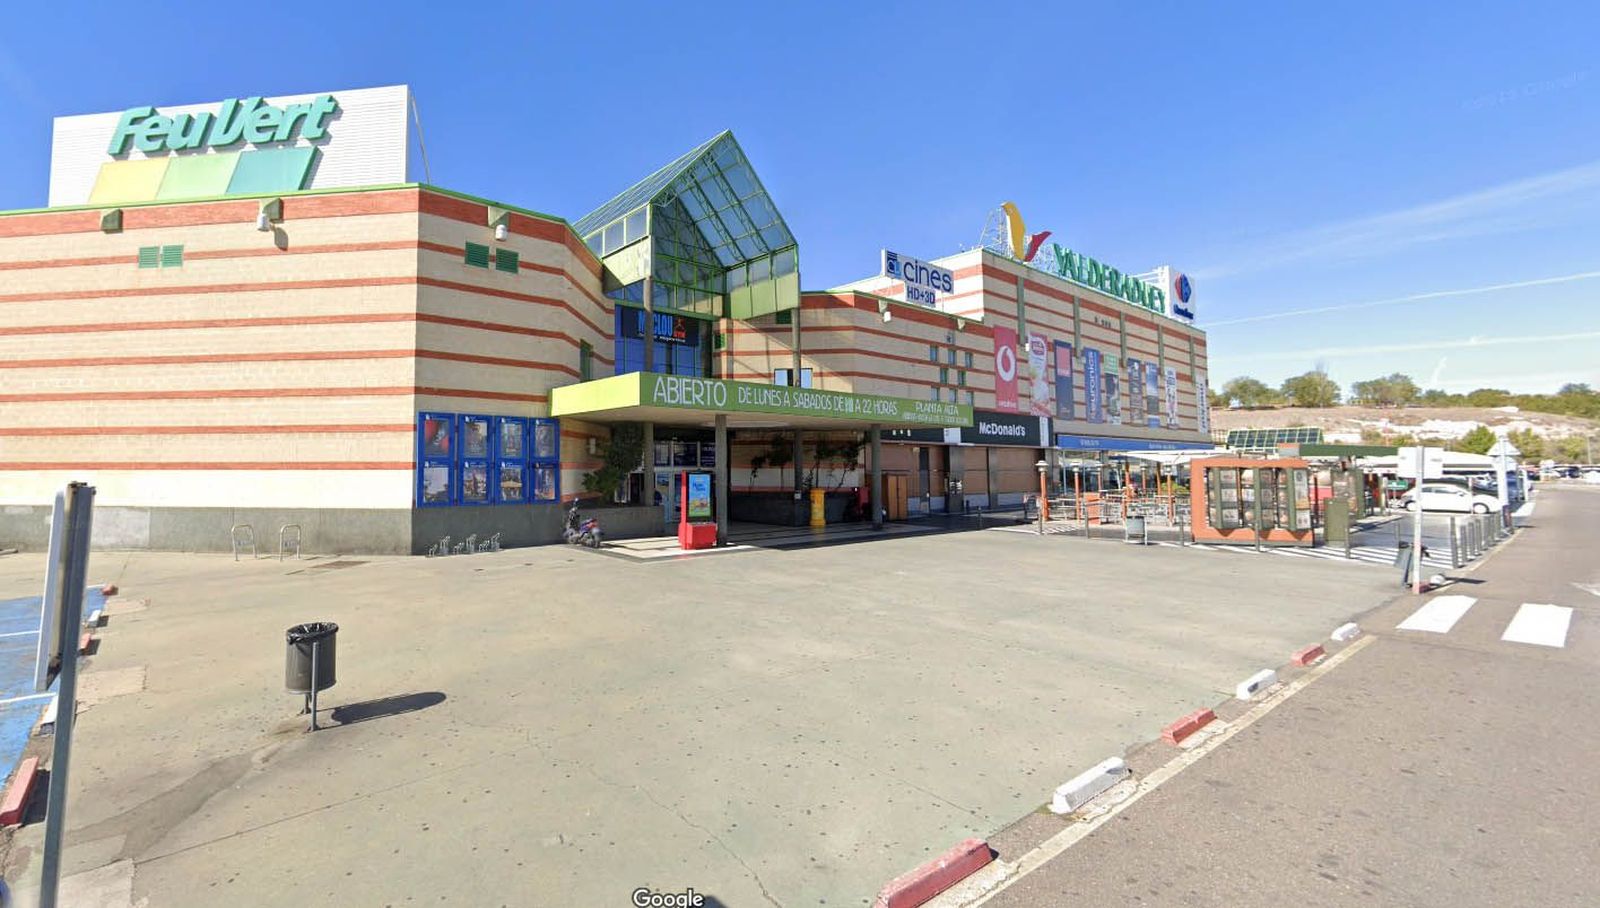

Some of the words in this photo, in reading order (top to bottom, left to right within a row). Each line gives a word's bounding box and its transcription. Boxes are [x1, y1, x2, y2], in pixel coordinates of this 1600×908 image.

[903, 259, 952, 292] cines
[907, 285, 936, 304] HD+3D
[653, 376, 727, 407] ABIERTO
[738, 387, 752, 404] DE
[754, 389, 781, 406] LUNES
[784, 391, 790, 408] A
[833, 395, 844, 412] DE
[855, 399, 861, 413] A
[863, 399, 873, 414] 22
[874, 401, 897, 416] HORAS
[979, 422, 1026, 437] McDonald's
